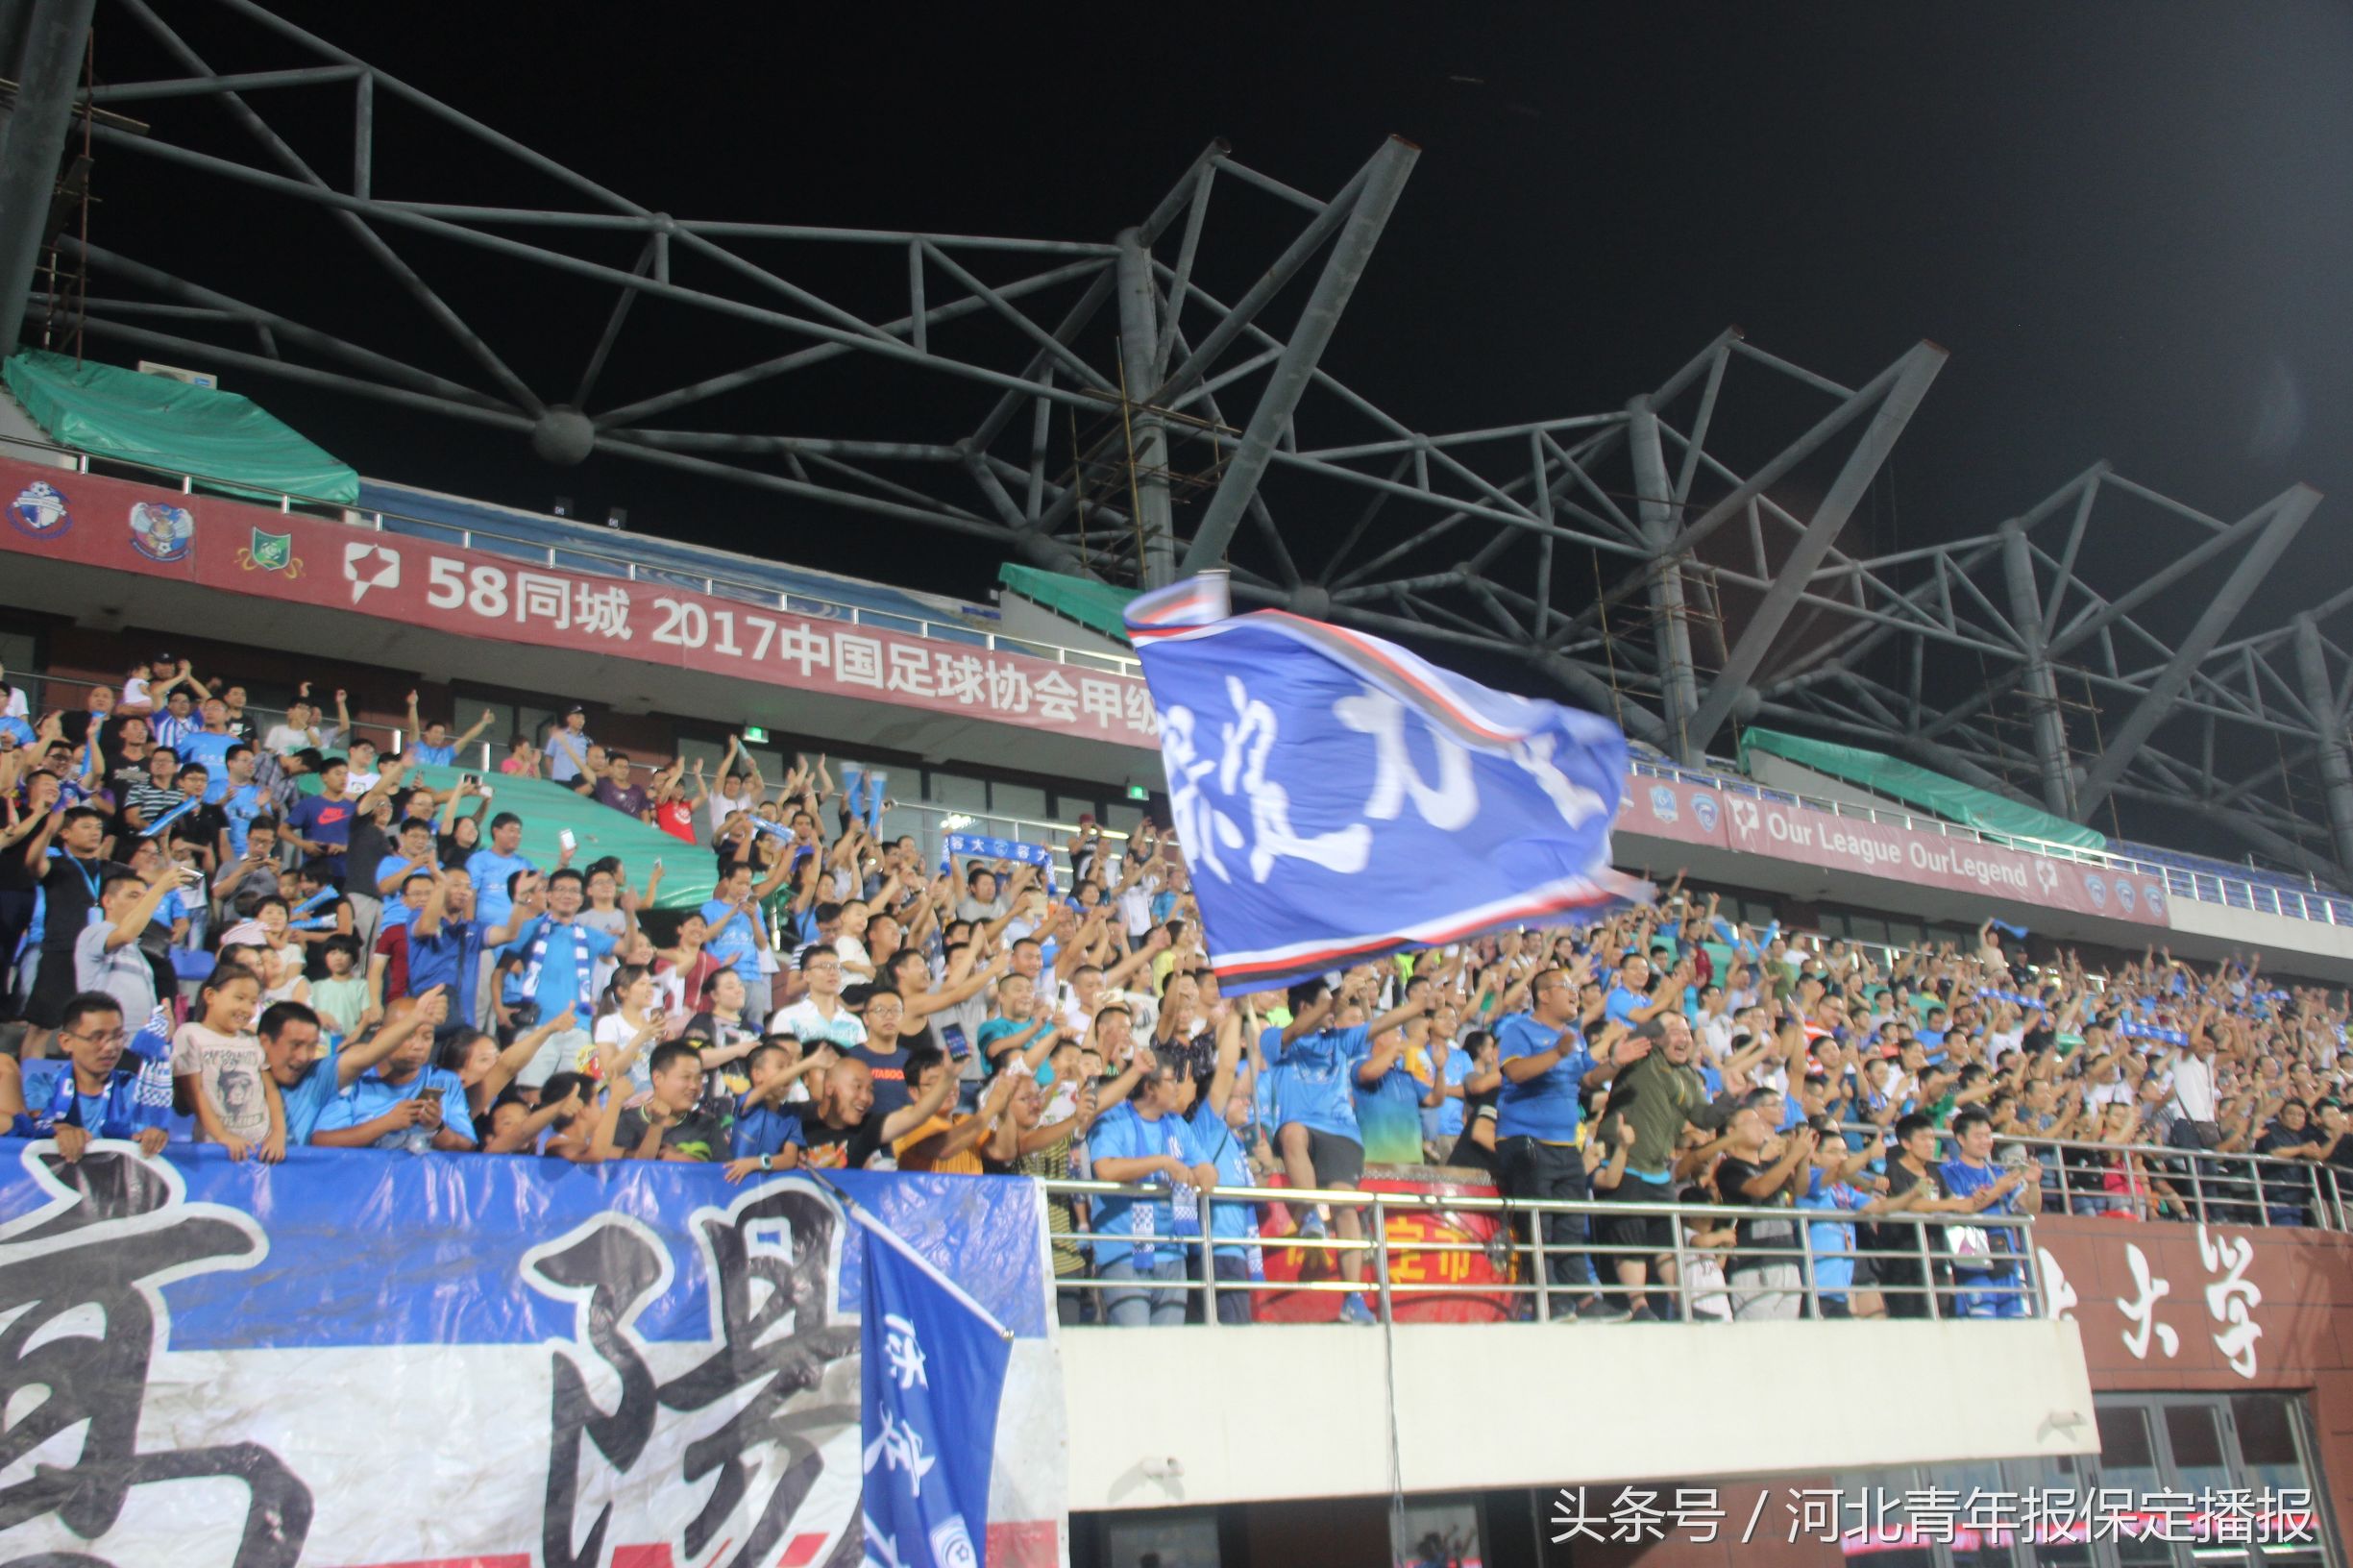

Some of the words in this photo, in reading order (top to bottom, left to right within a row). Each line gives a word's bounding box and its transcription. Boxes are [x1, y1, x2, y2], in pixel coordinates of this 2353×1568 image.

[426, 555, 633, 641] 58同城
[1768, 812, 1812, 846] Our
[1818, 821, 1901, 865] League
